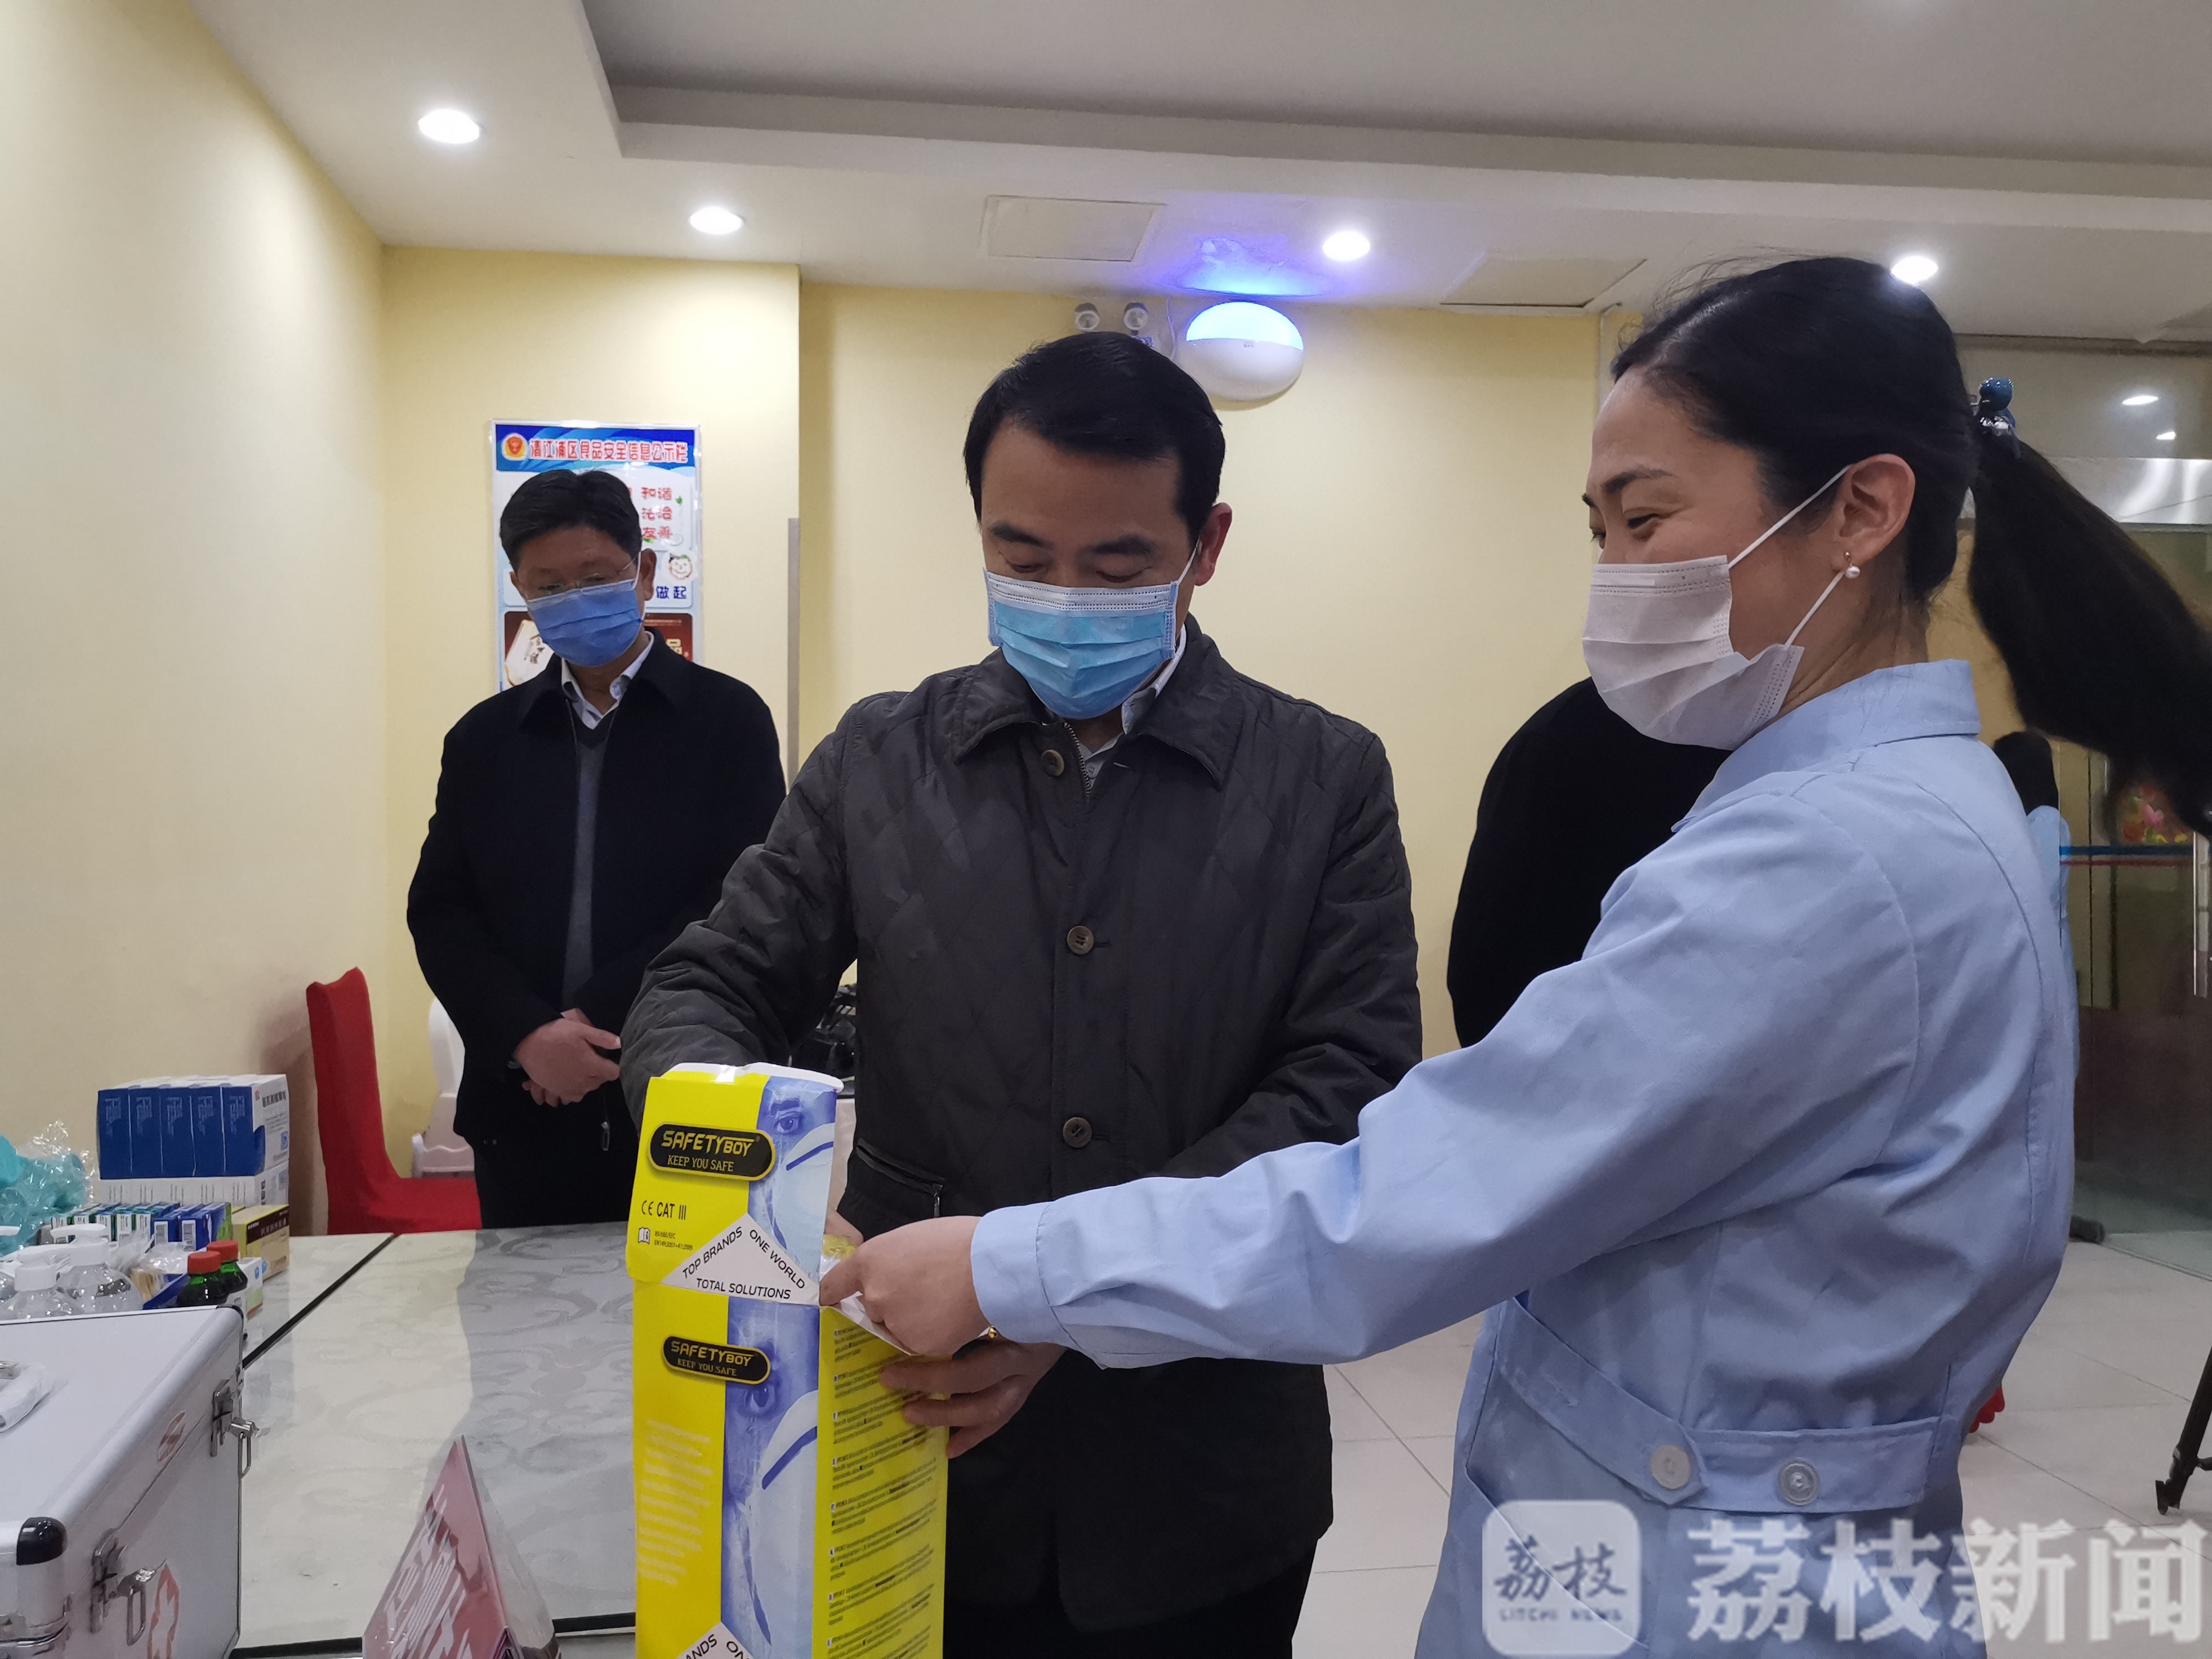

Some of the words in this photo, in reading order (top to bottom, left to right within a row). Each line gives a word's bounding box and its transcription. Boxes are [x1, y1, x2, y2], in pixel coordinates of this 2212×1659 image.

[641, 487, 672, 500] 和谐
[661, 1130, 755, 1157] SAFETYBOY
[667, 1155, 690, 1167] KEEP
[692, 1158, 709, 1169] YOU
[710, 1160, 734, 1172] SAFE
[657, 1202, 675, 1218] CAT
[682, 1258, 701, 1279] TOP
[704, 1226, 742, 1264] BRANDS
[750, 1230, 770, 1253] ONE
[770, 1250, 805, 1289] WORLD
[696, 1278, 726, 1292] TOTAL
[729, 1283, 791, 1299] SOLUTIONS
[671, 1341, 754, 1366] SAFETYBOY
[698, 1362, 714, 1372] YOU
[716, 1366, 737, 1376] SAFE
